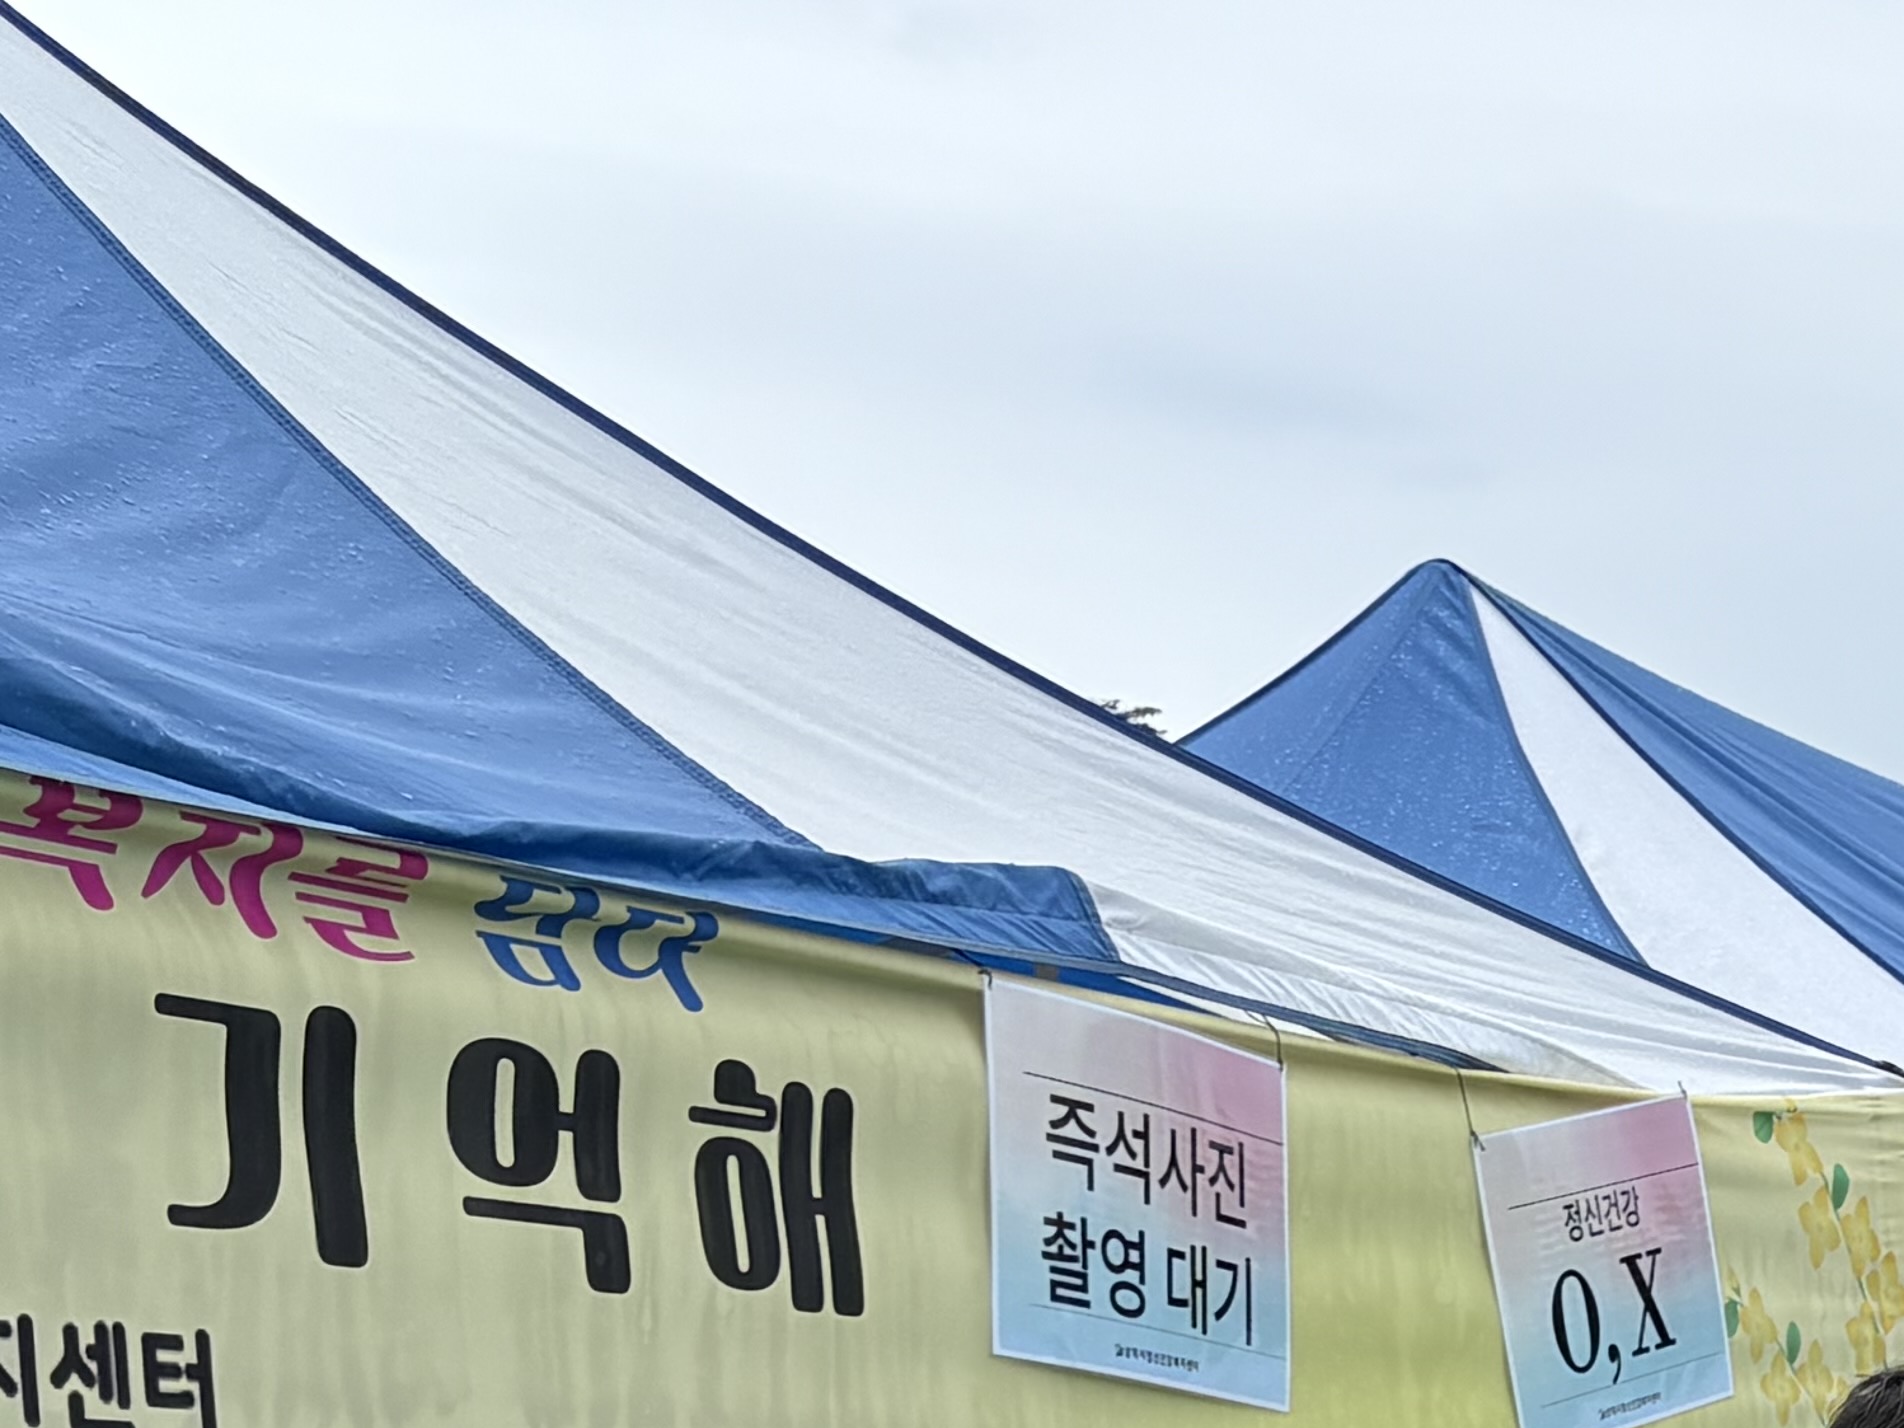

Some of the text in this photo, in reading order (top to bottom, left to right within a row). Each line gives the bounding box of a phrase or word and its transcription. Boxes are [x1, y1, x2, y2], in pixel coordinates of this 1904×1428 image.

[0, 774, 719, 1012] 복지를 담다
[1046, 1093, 1247, 1229] 즉석사진
[1562, 1186, 1640, 1242] 정신건강
[1041, 1211, 1252, 1346] 촬영 대기
[1552, 1247, 1677, 1385] O,X
